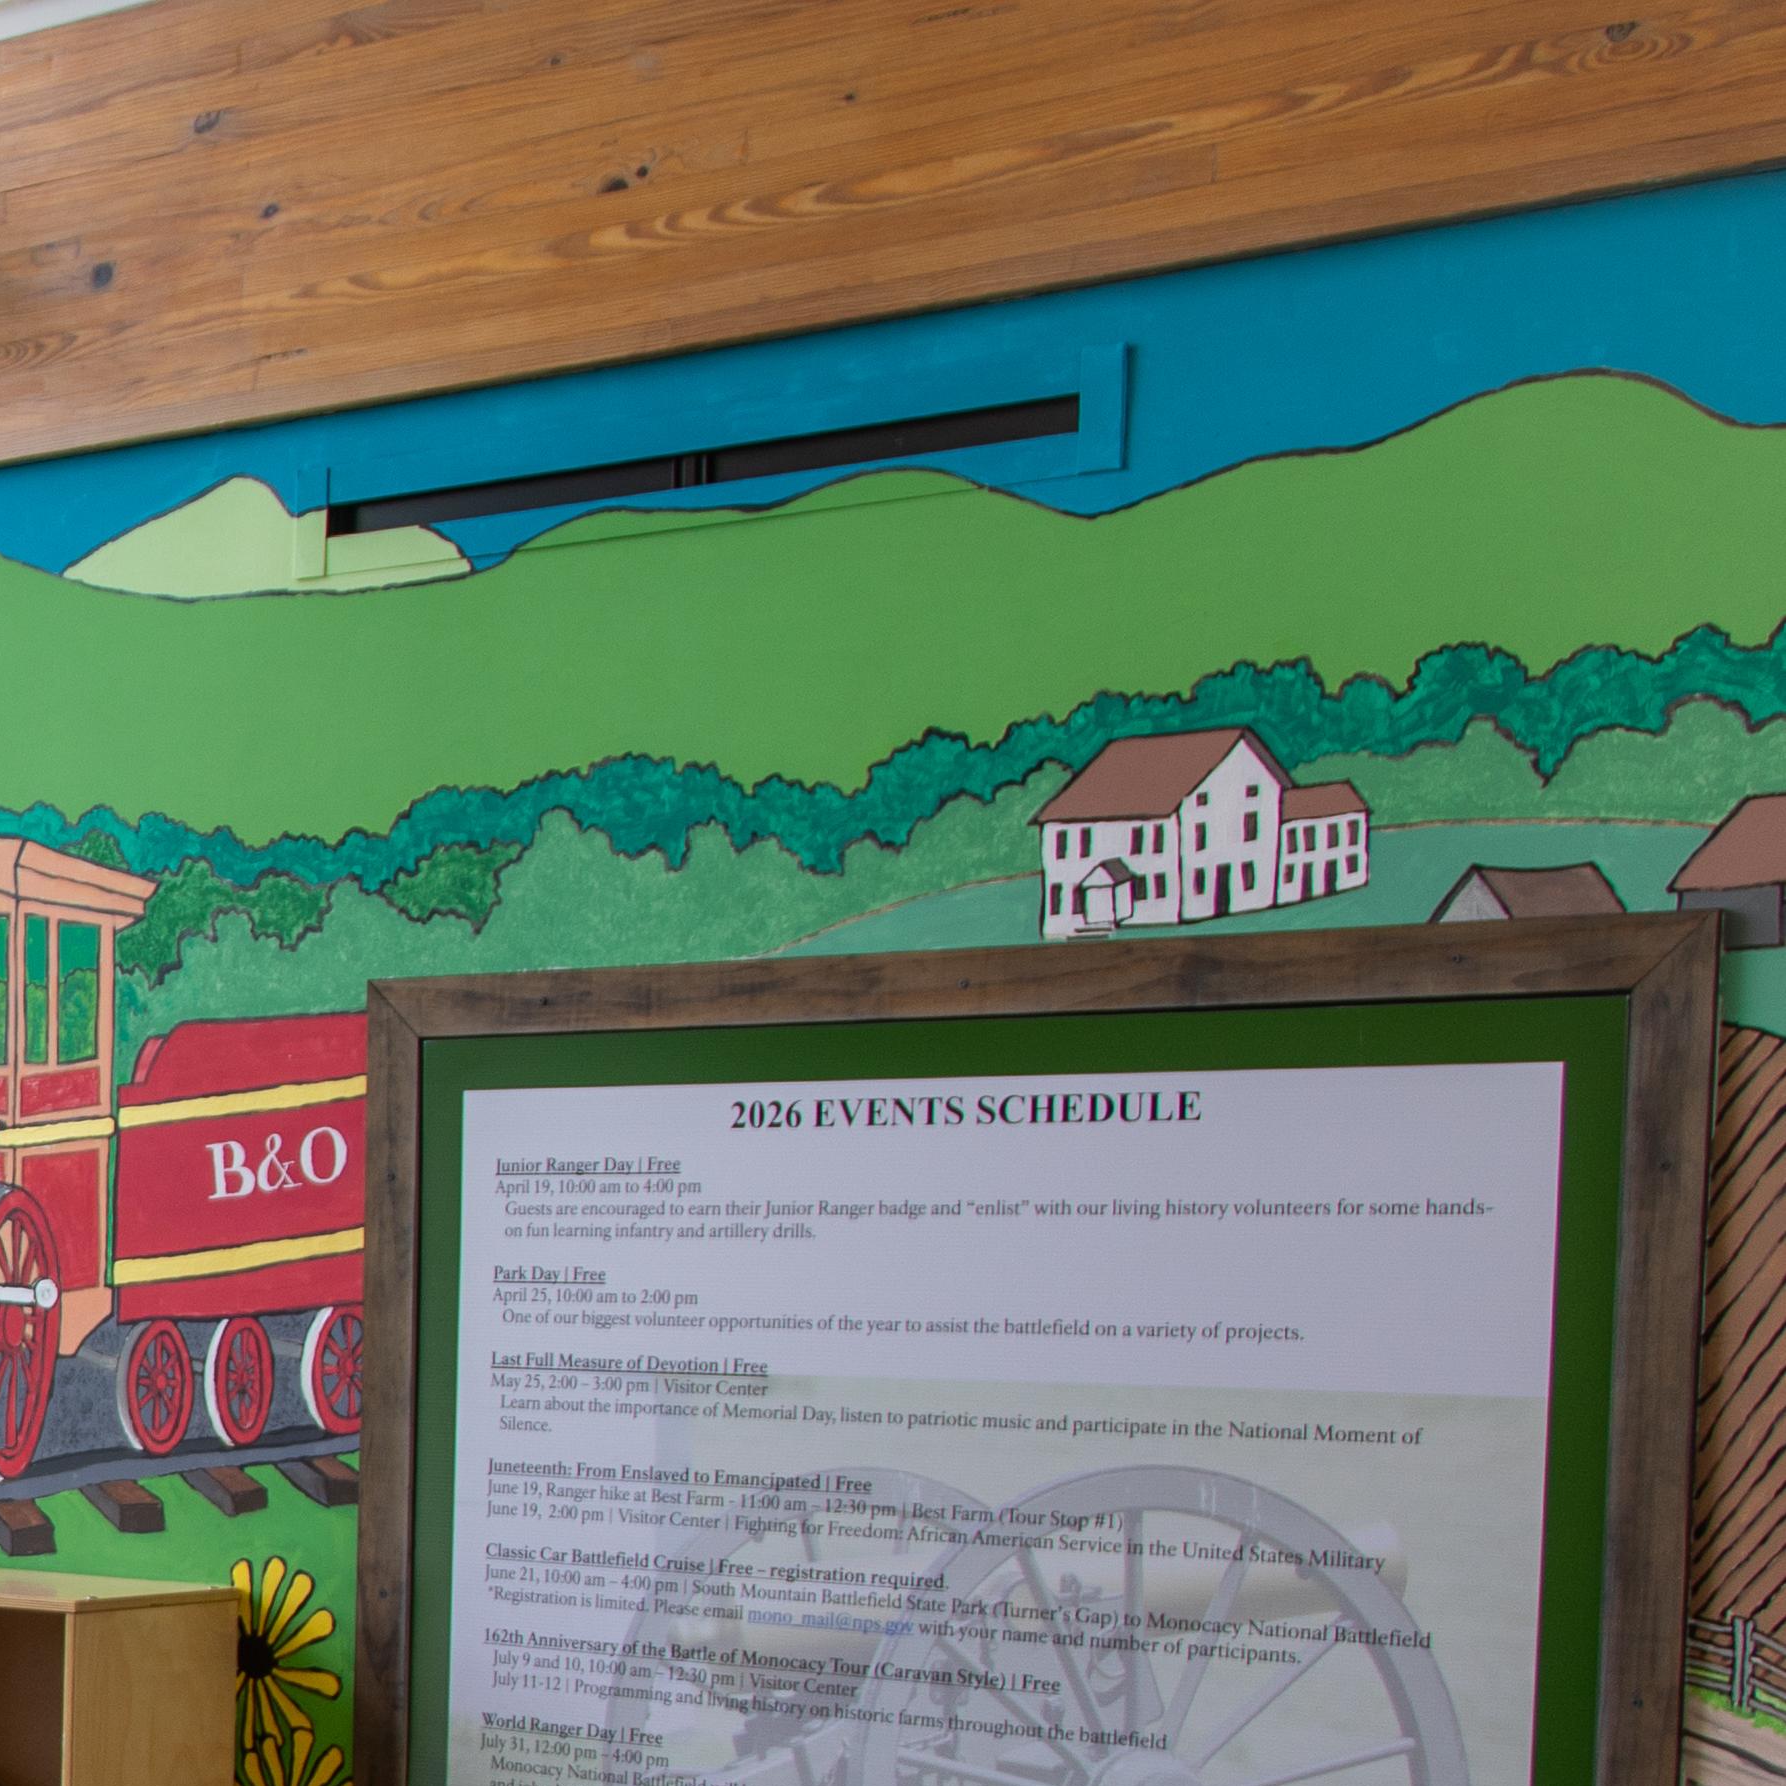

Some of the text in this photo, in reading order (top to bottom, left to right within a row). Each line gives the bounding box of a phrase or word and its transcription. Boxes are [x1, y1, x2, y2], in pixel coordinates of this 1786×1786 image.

[729, 1091, 1203, 1129] 2026 EVENTS SCHEDULE
[205, 1126, 348, 1200] B&O
[495, 1158, 541, 1175] Junior
[546, 1157, 599, 1175] Ranger
[604, 1157, 633, 1174] Day
[647, 1156, 681, 1170] Free
[494, 1178, 702, 1196] April 19, 10:00 am to 4:00 pm
[503, 1223, 817, 1240] on fun learning infantry and artillery drills.
[493, 1266, 525, 1280] Park
[531, 1266, 559, 1283] Day
[573, 1266, 606, 1280] Free
[490, 1351, 520, 1365] Last
[526, 1352, 553, 1366] Full
[559, 1353, 622, 1368] Measure
[627, 1354, 643, 1369] of
[647, 1355, 717, 1371] Devotion
[734, 1357, 768, 1372] Free
[498, 1416, 552, 1432] Silence.
[481, 1712, 525, 1730] World
[530, 1717, 582, 1739] Ranger
[586, 1723, 616, 1742] Day
[630, 1727, 663, 1744] Free
